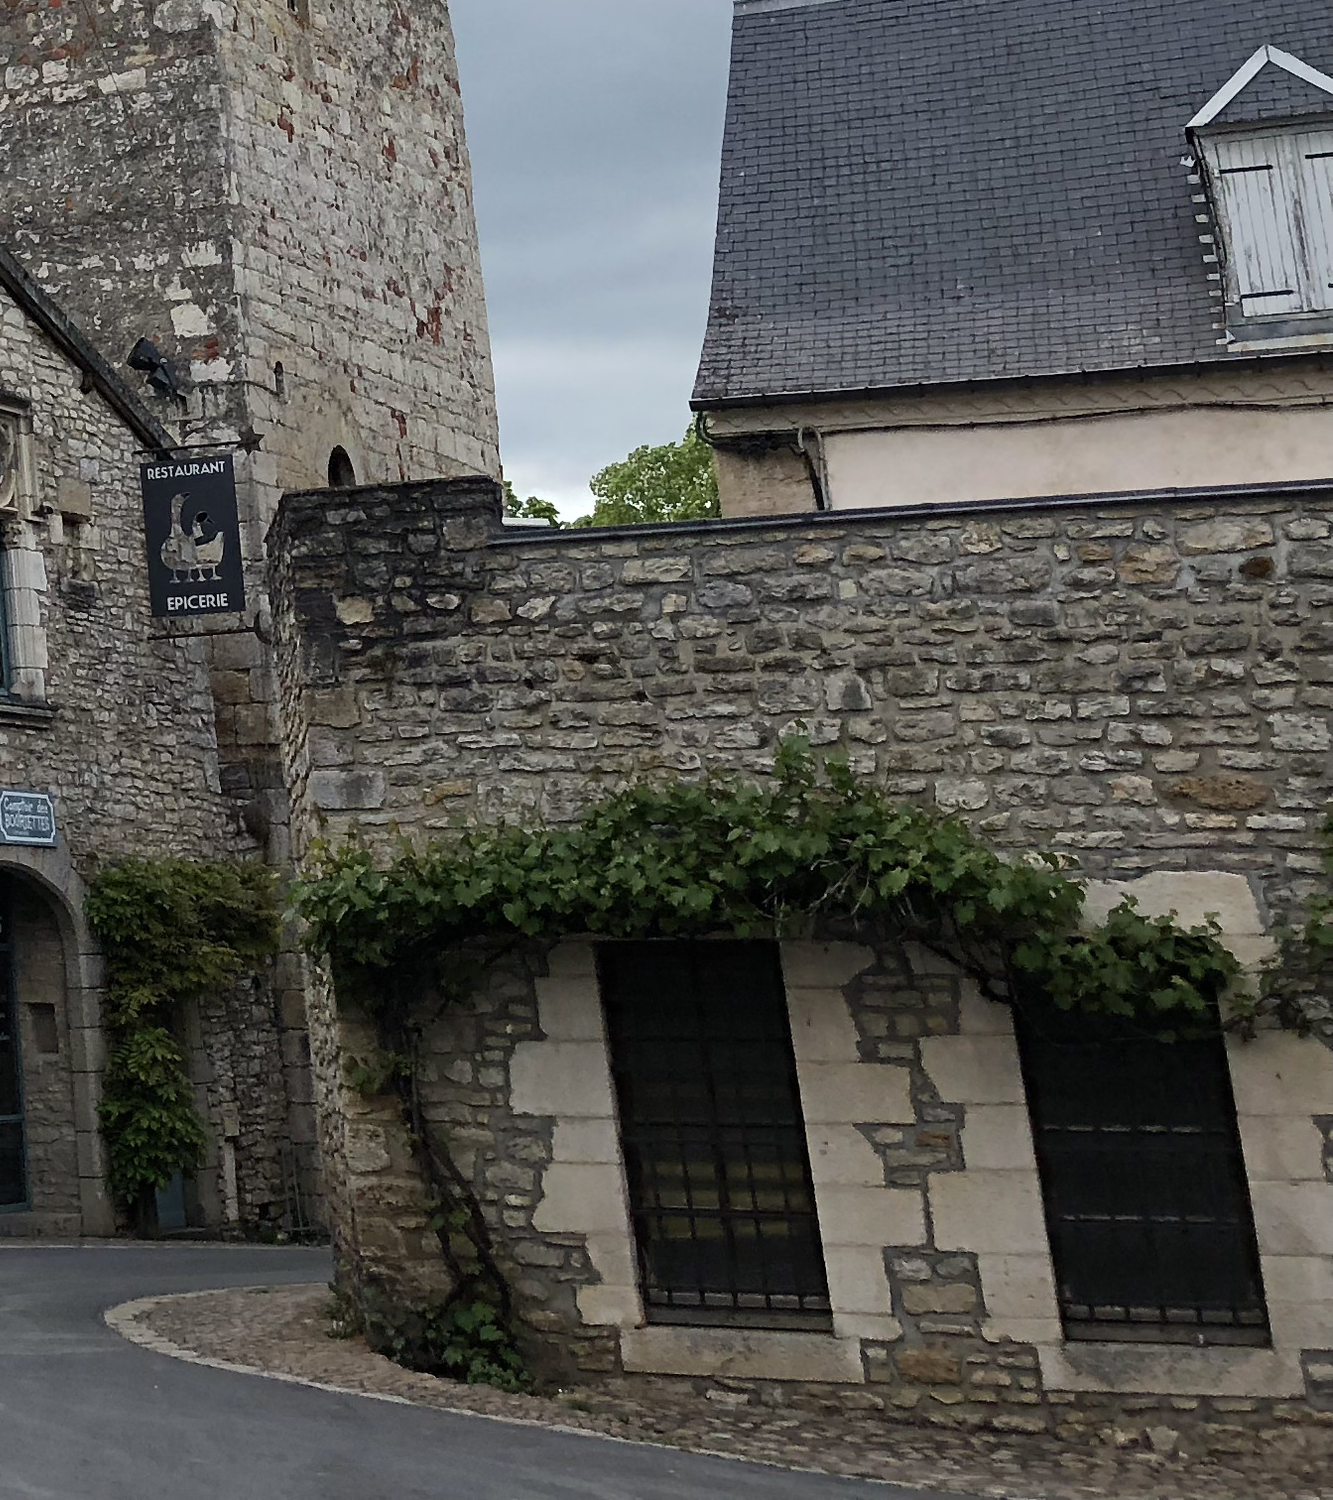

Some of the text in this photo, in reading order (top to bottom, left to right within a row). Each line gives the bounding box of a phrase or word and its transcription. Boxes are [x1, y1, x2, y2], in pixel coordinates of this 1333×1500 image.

[147, 461, 226, 480] RESTAURANT
[166, 593, 229, 611] EPICERIE
[4, 813, 50, 831] BOURIETTES
